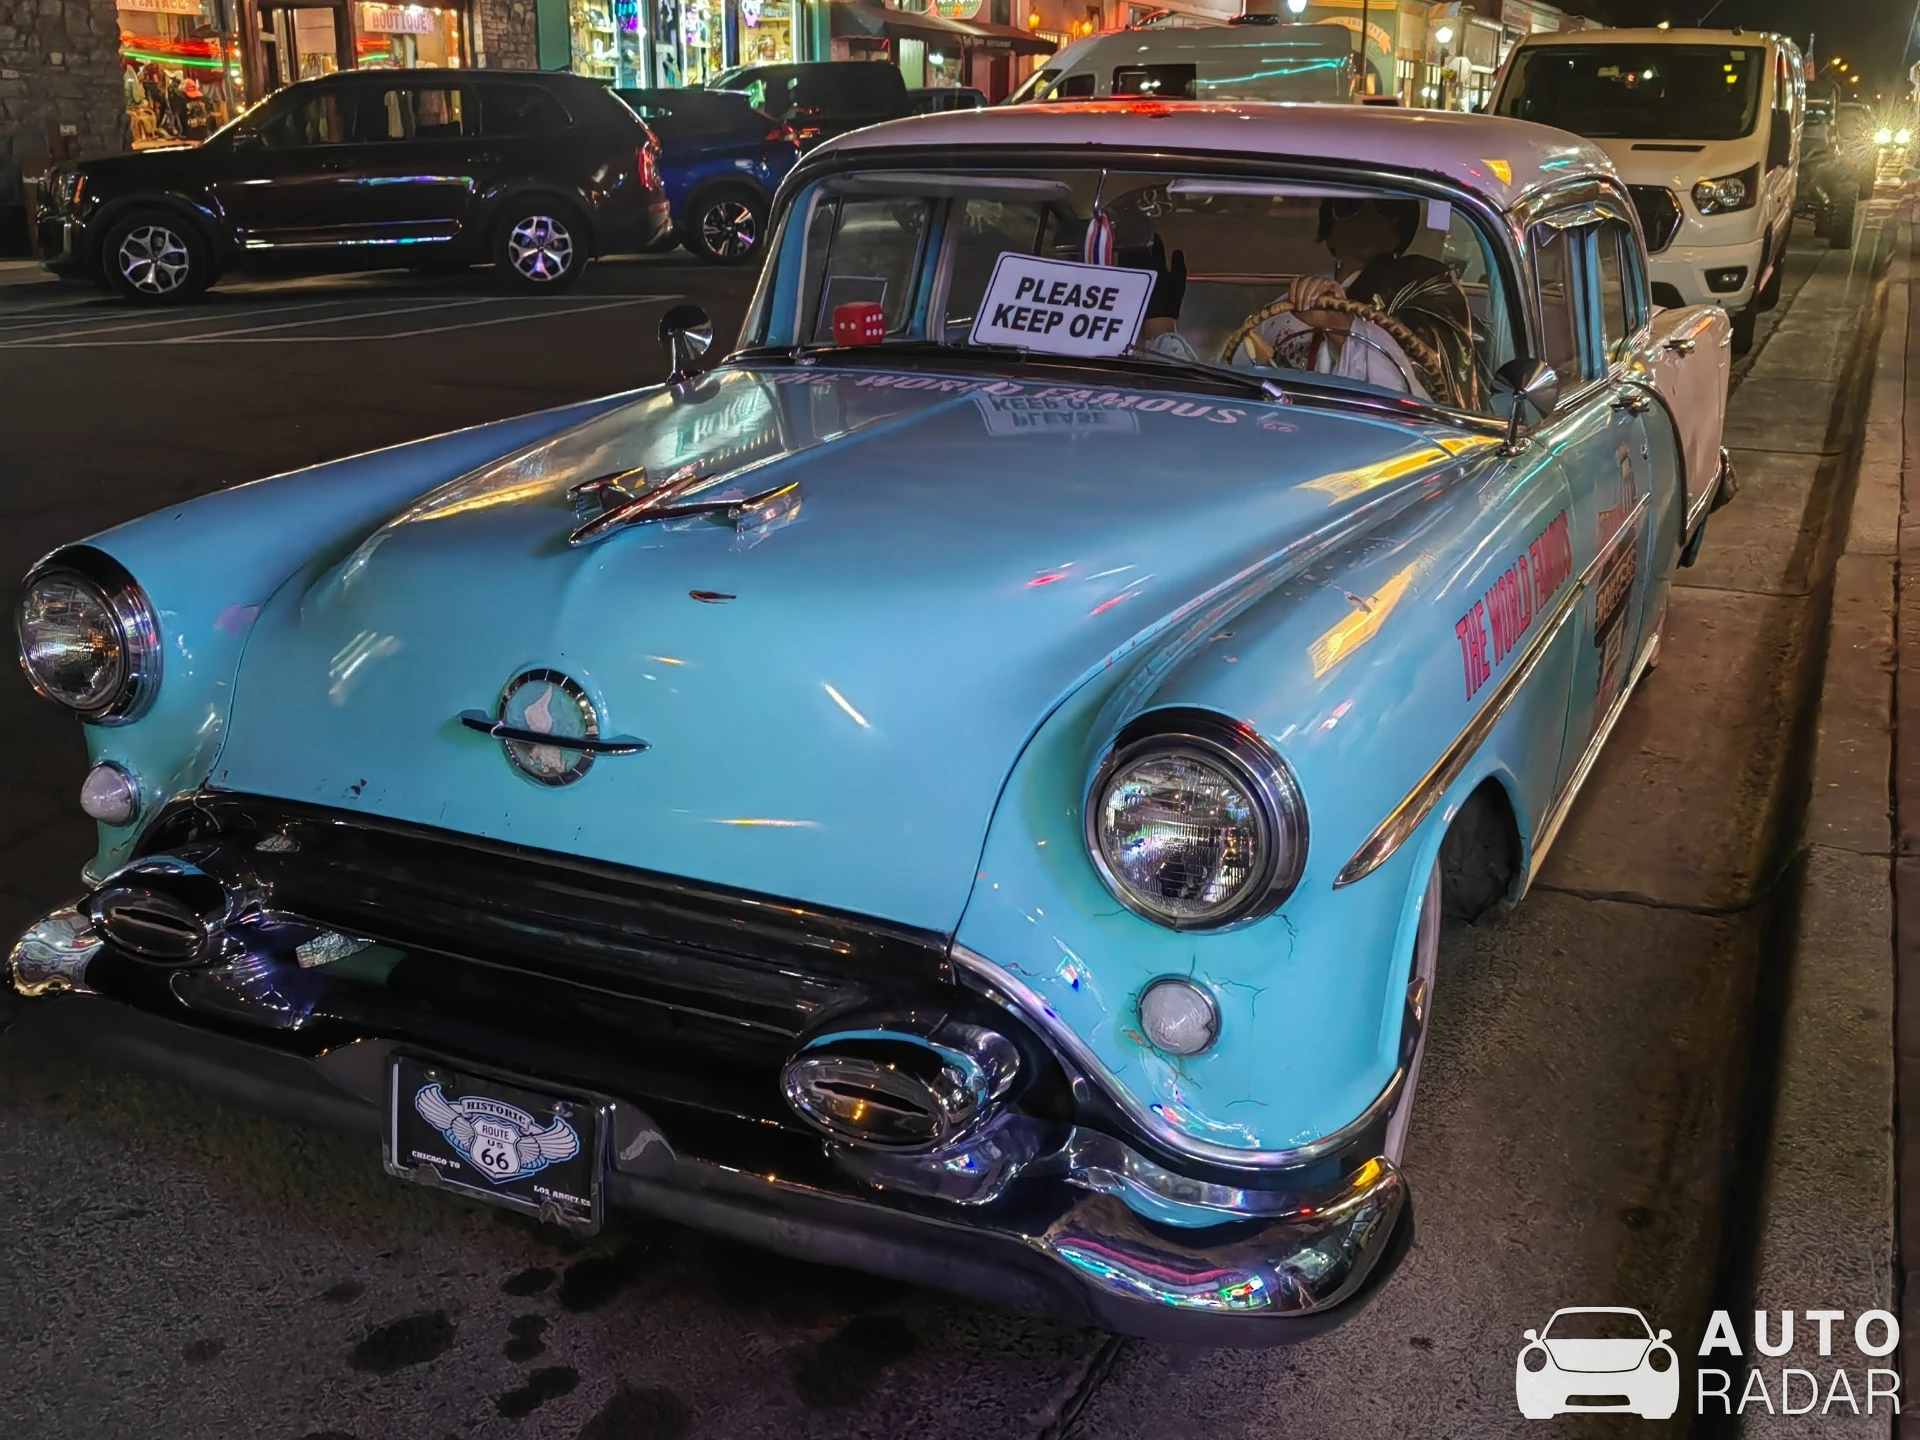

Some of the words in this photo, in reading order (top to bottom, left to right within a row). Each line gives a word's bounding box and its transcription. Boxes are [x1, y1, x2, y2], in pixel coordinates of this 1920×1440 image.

[372, 11, 428, 31] BOUTIQUE
[1015, 276, 1120, 311] PLEASE
[991, 303, 1064, 334] KEEP
[1069, 313, 1123, 342] OFF
[1034, 386, 1248, 424] FAMOUS
[1454, 599, 1491, 702] THE
[1485, 554, 1532, 667] WORLD
[466, 1101, 527, 1126] HISTORIC
[482, 1123, 510, 1140] ROUTE
[487, 1138, 504, 1149] US
[411, 1150, 448, 1166] CHICAGO
[448, 1159, 461, 1169] TO
[481, 1148, 510, 1171] 66
[533, 1185, 550, 1197] LOS
[551, 1190, 592, 1208] ANGELES
